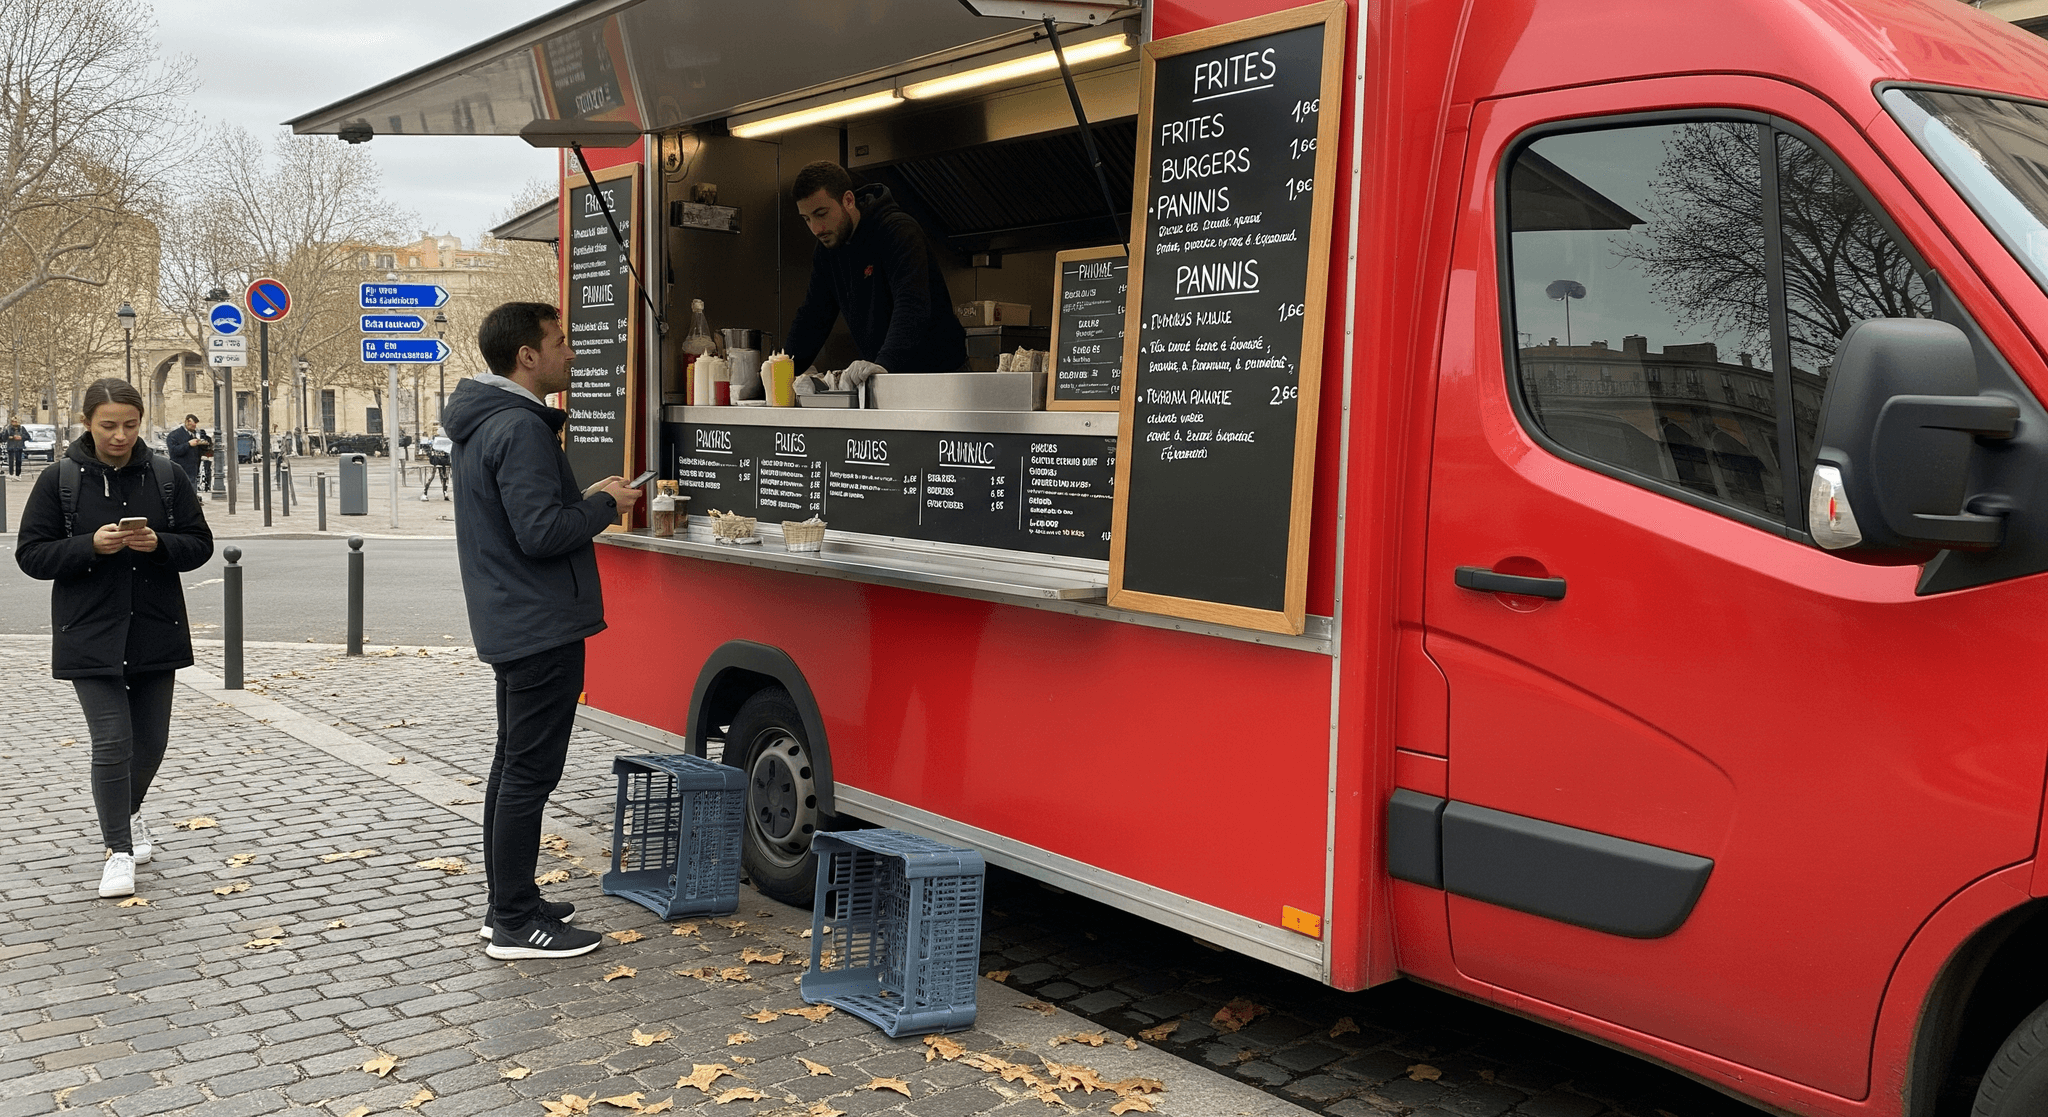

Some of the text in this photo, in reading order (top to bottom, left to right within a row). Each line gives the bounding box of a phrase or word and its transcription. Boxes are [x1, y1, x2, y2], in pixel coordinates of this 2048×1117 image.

[1194, 48, 1276, 95] FRITES
[1161, 112, 1225, 146] FRITES
[1161, 147, 1250, 183] BURGERS
[1157, 186, 1230, 220] PANINIS
[1176, 259, 1260, 295] PANINIS
